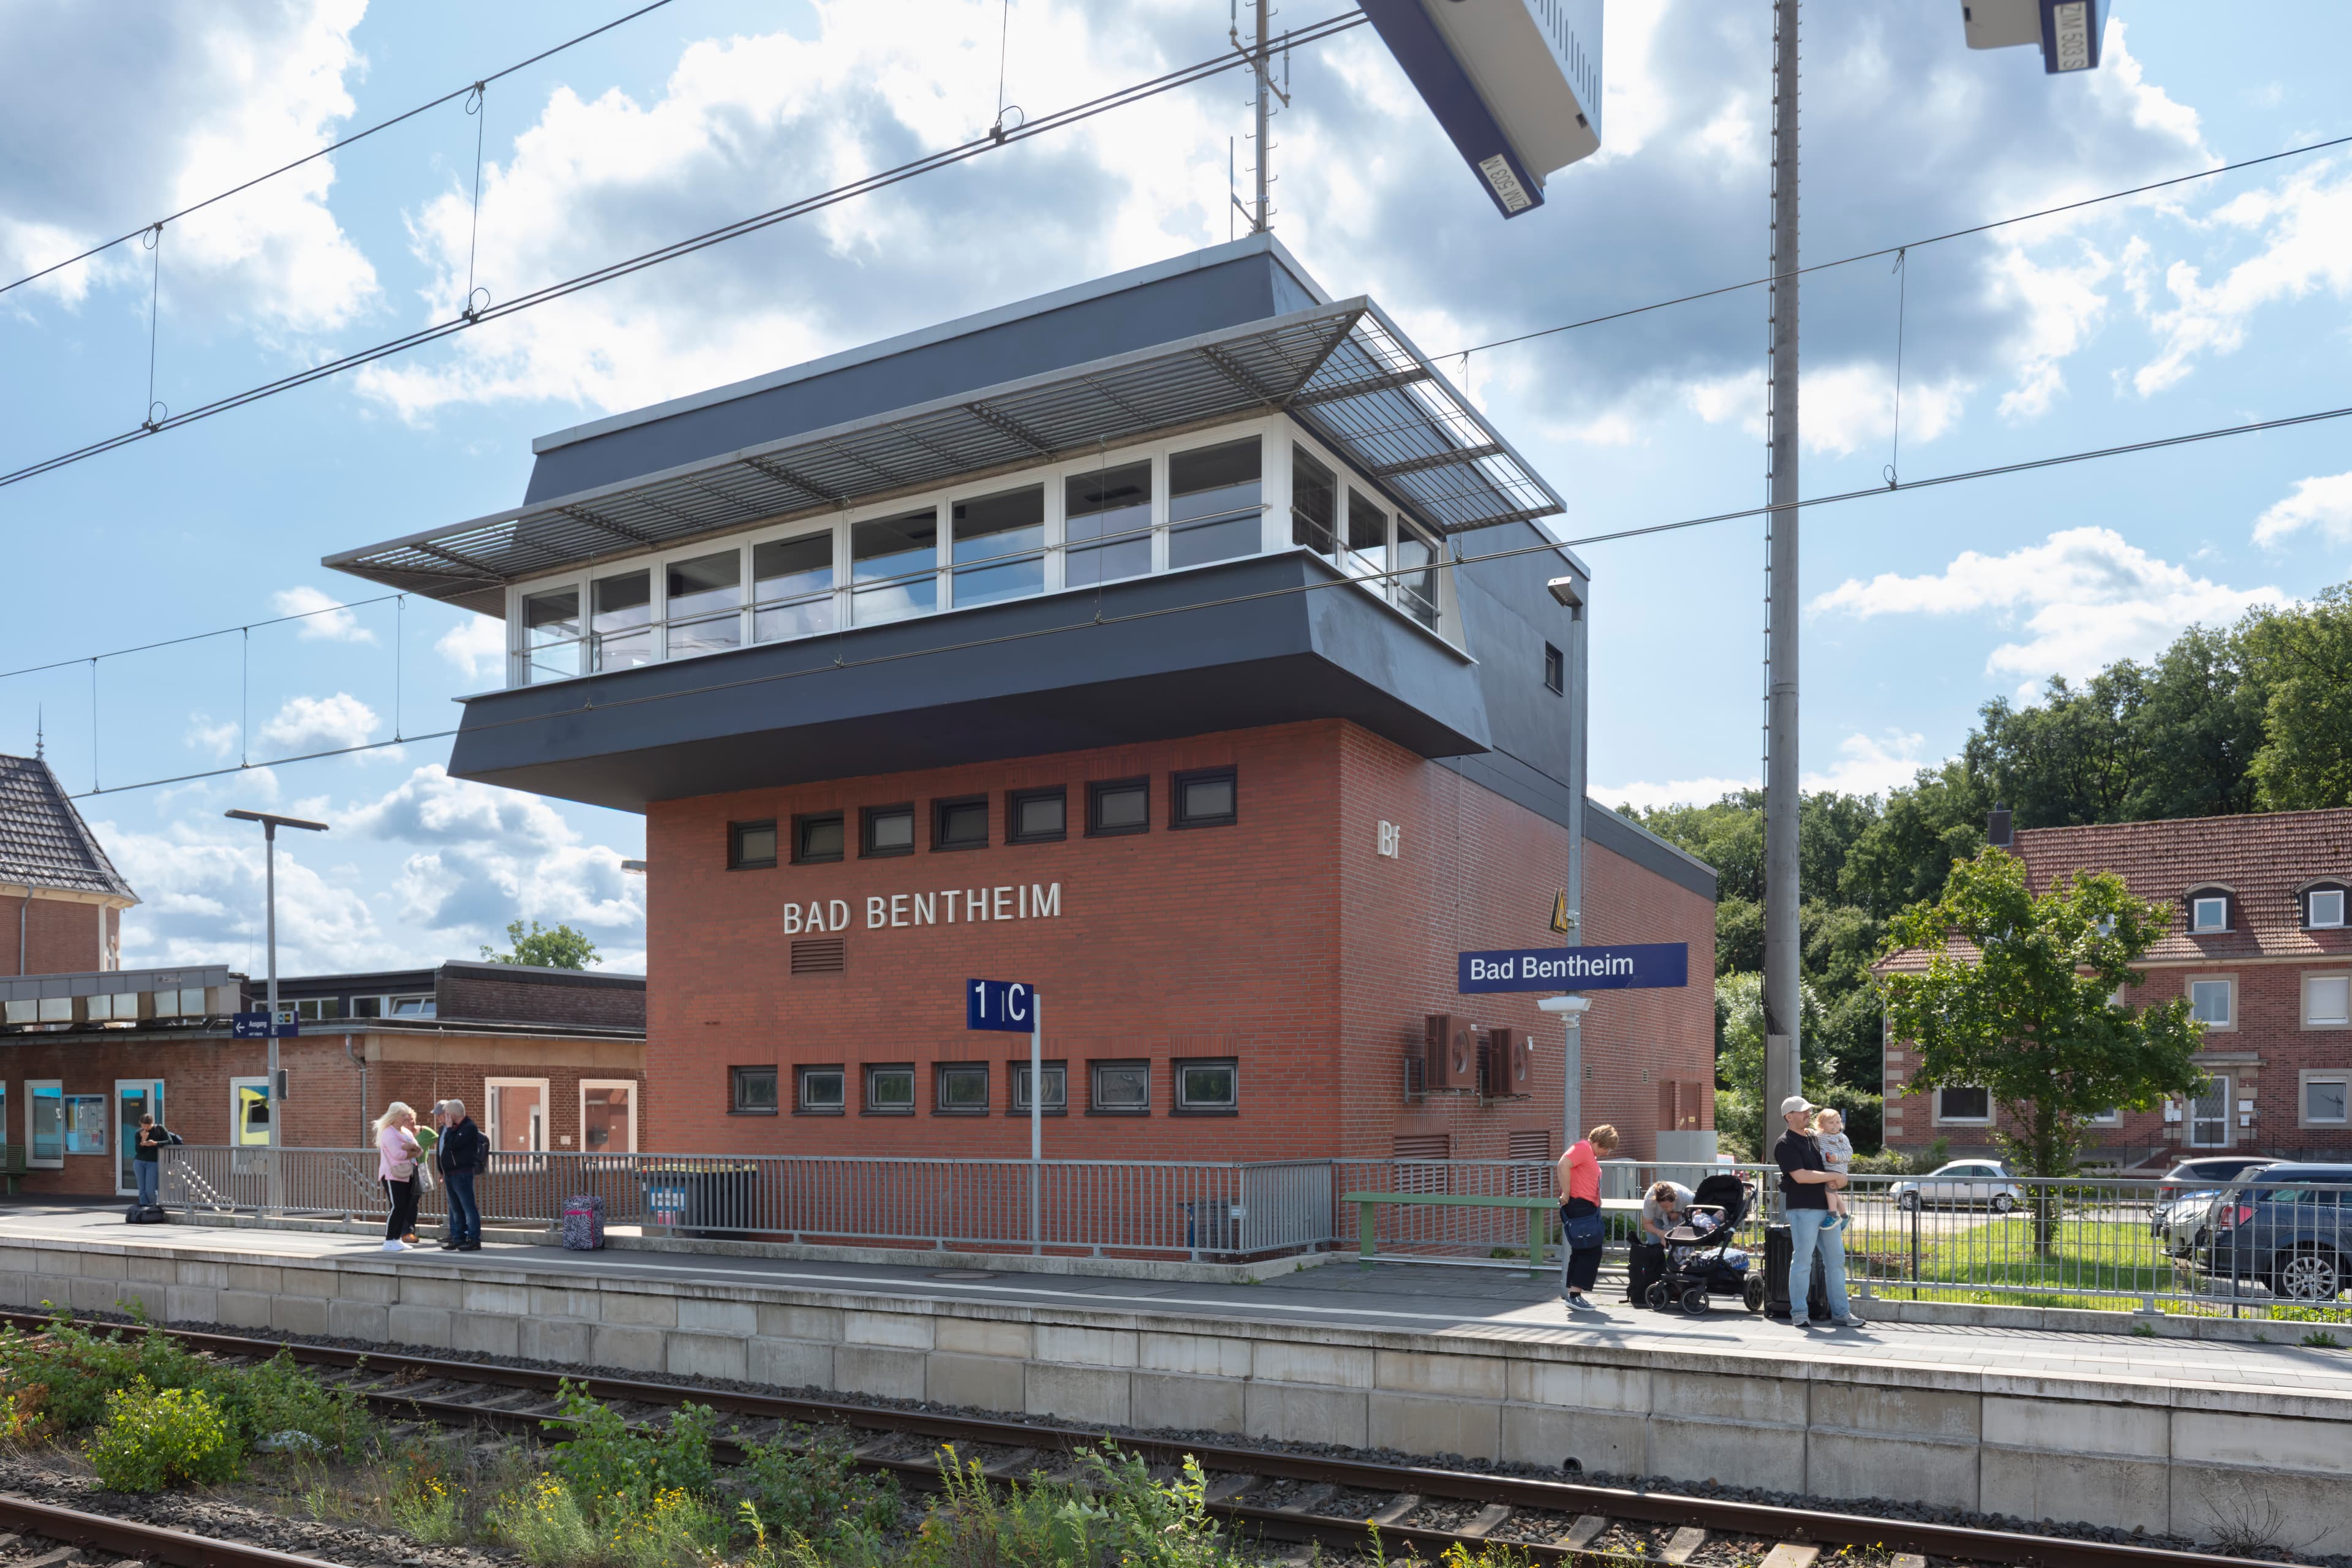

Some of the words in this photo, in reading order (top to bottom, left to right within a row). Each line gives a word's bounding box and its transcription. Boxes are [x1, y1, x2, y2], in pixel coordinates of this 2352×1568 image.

[2060, 4, 2082, 31] ZIM
[2061, 32, 2084, 56] 503
[2062, 58, 2084, 69] S
[1482, 156, 1502, 171] M
[1490, 168, 1515, 190] 503
[1503, 188, 1528, 210] ZIM
[784, 899, 851, 934] BAD
[867, 882, 1061, 929] BENTHEIM
[1471, 957, 1513, 980] Bad
[1523, 953, 1634, 978] Bentheim
[975, 981, 985, 1018] 1
[1008, 983, 1025, 1021] C
